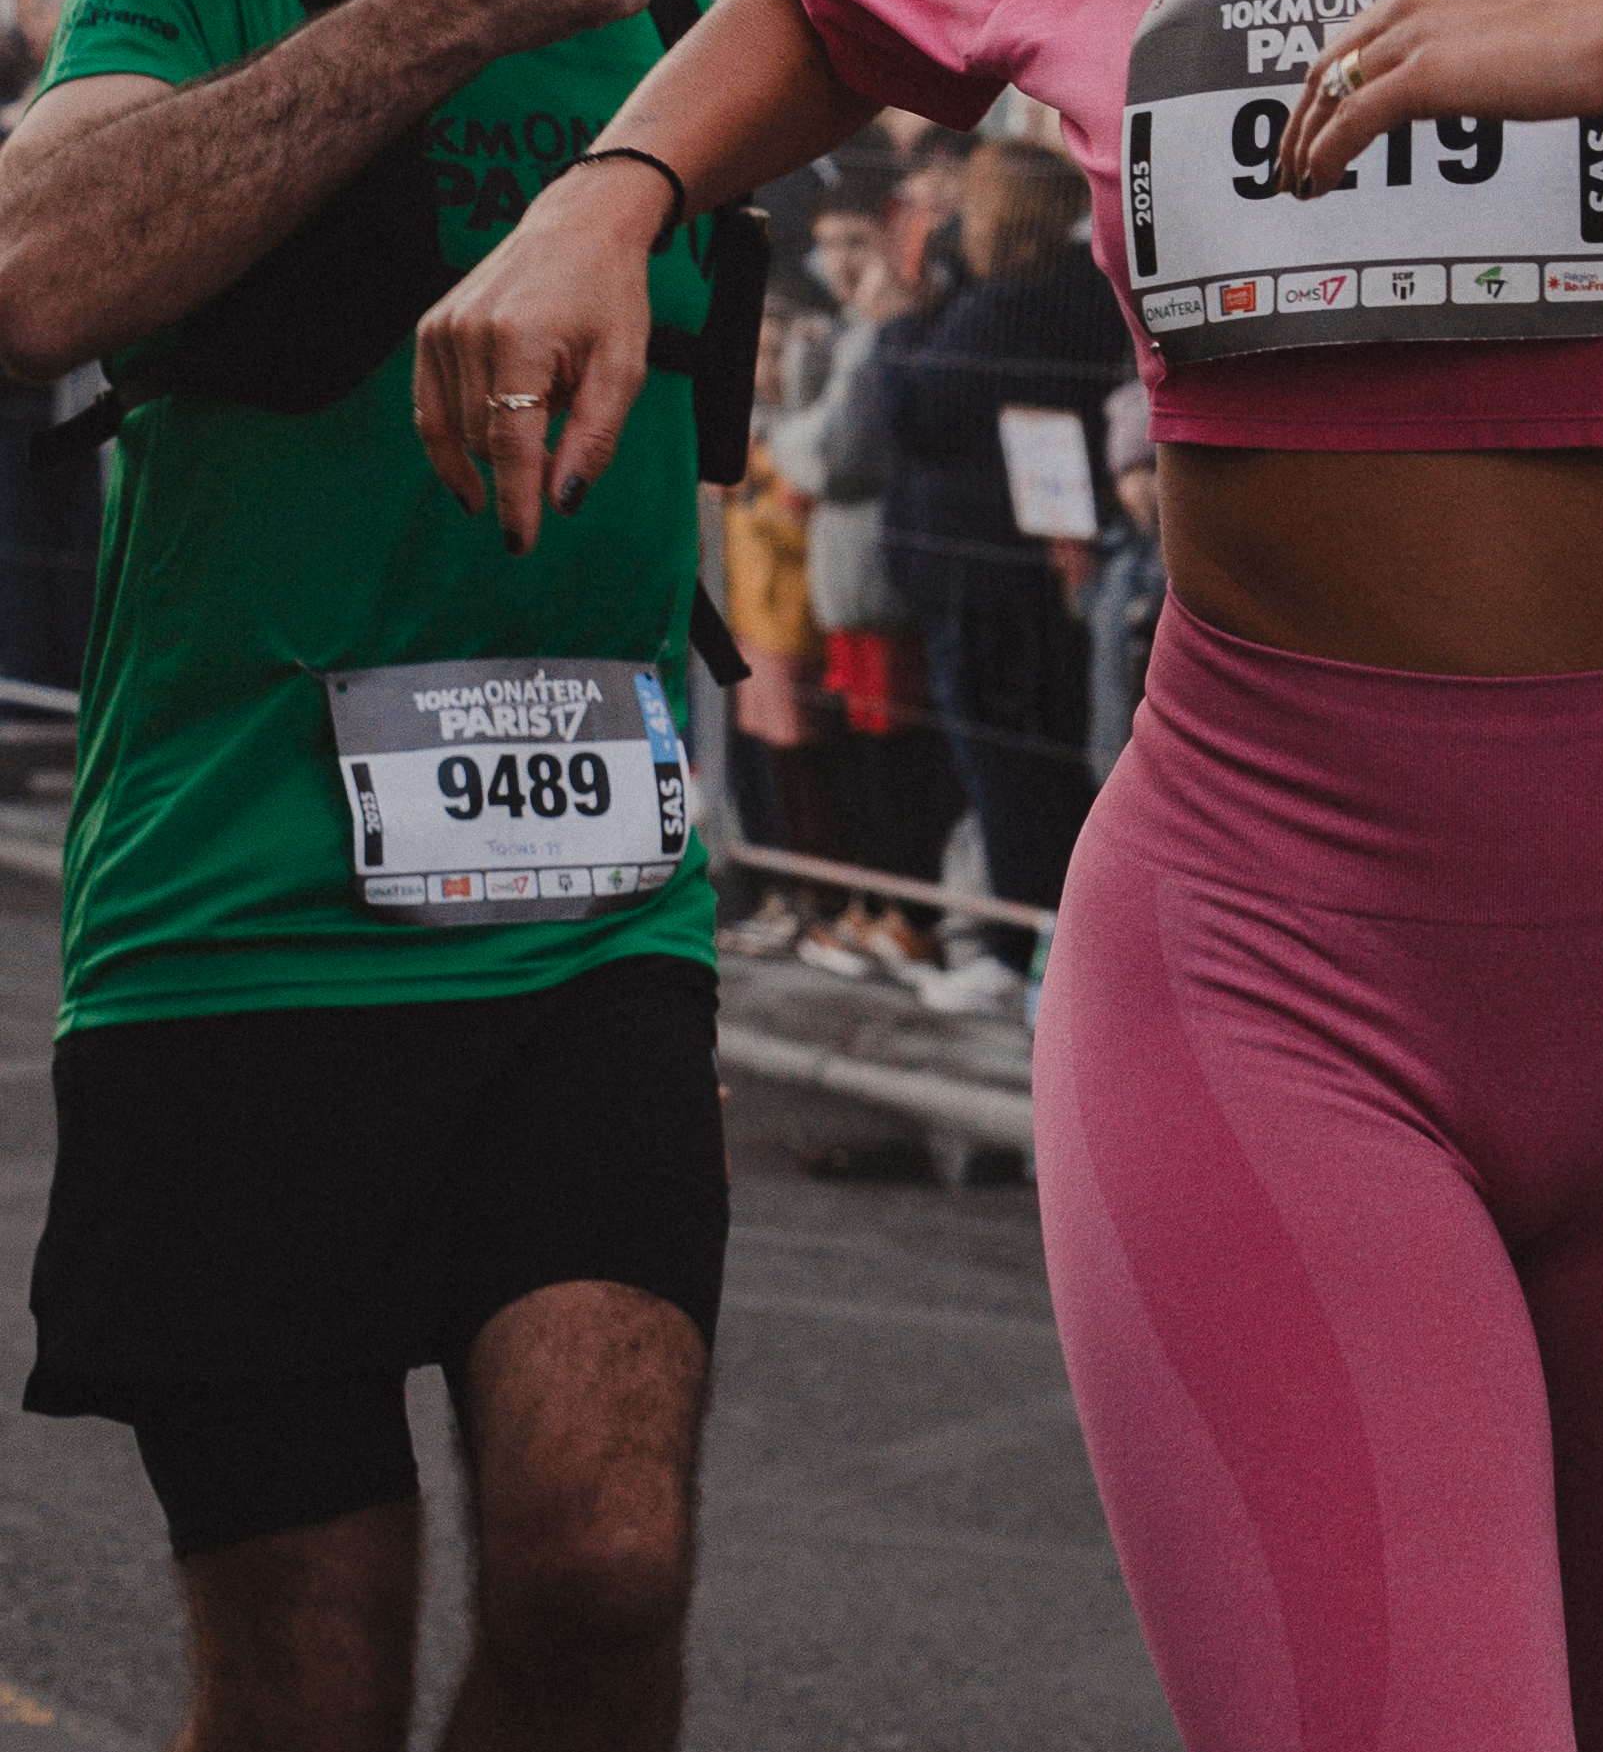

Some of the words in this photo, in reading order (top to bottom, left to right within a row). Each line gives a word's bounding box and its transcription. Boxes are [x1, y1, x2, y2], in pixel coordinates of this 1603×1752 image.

[1231, 97, 1504, 200] 919
[1133, 159, 1153, 226] 2025
[1145, 298, 1202, 323] ONATERA
[437, 752, 611, 820] 9489
[659, 777, 685, 836] SAS
